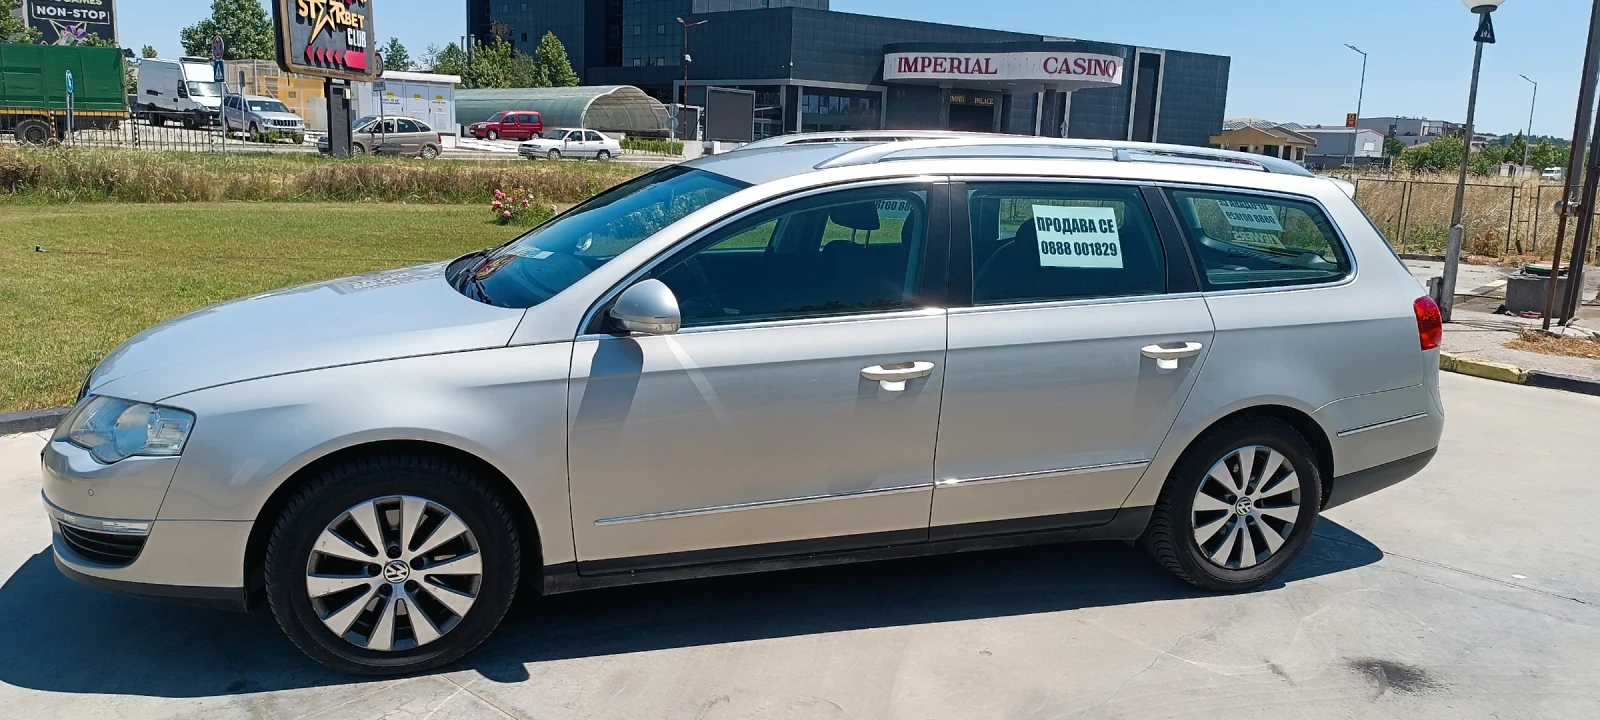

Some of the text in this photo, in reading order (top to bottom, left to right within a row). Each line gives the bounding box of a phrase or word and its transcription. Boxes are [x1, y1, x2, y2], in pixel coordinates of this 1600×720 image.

[36, 5, 106, 20] NON-STOP
[347, 27, 367, 48] CLUB
[897, 56, 1117, 78] IMPERIAL CASINO
[1036, 216, 1115, 235] ПРОДАВА СЕ
[1041, 240, 1118, 257] 0888 001829
